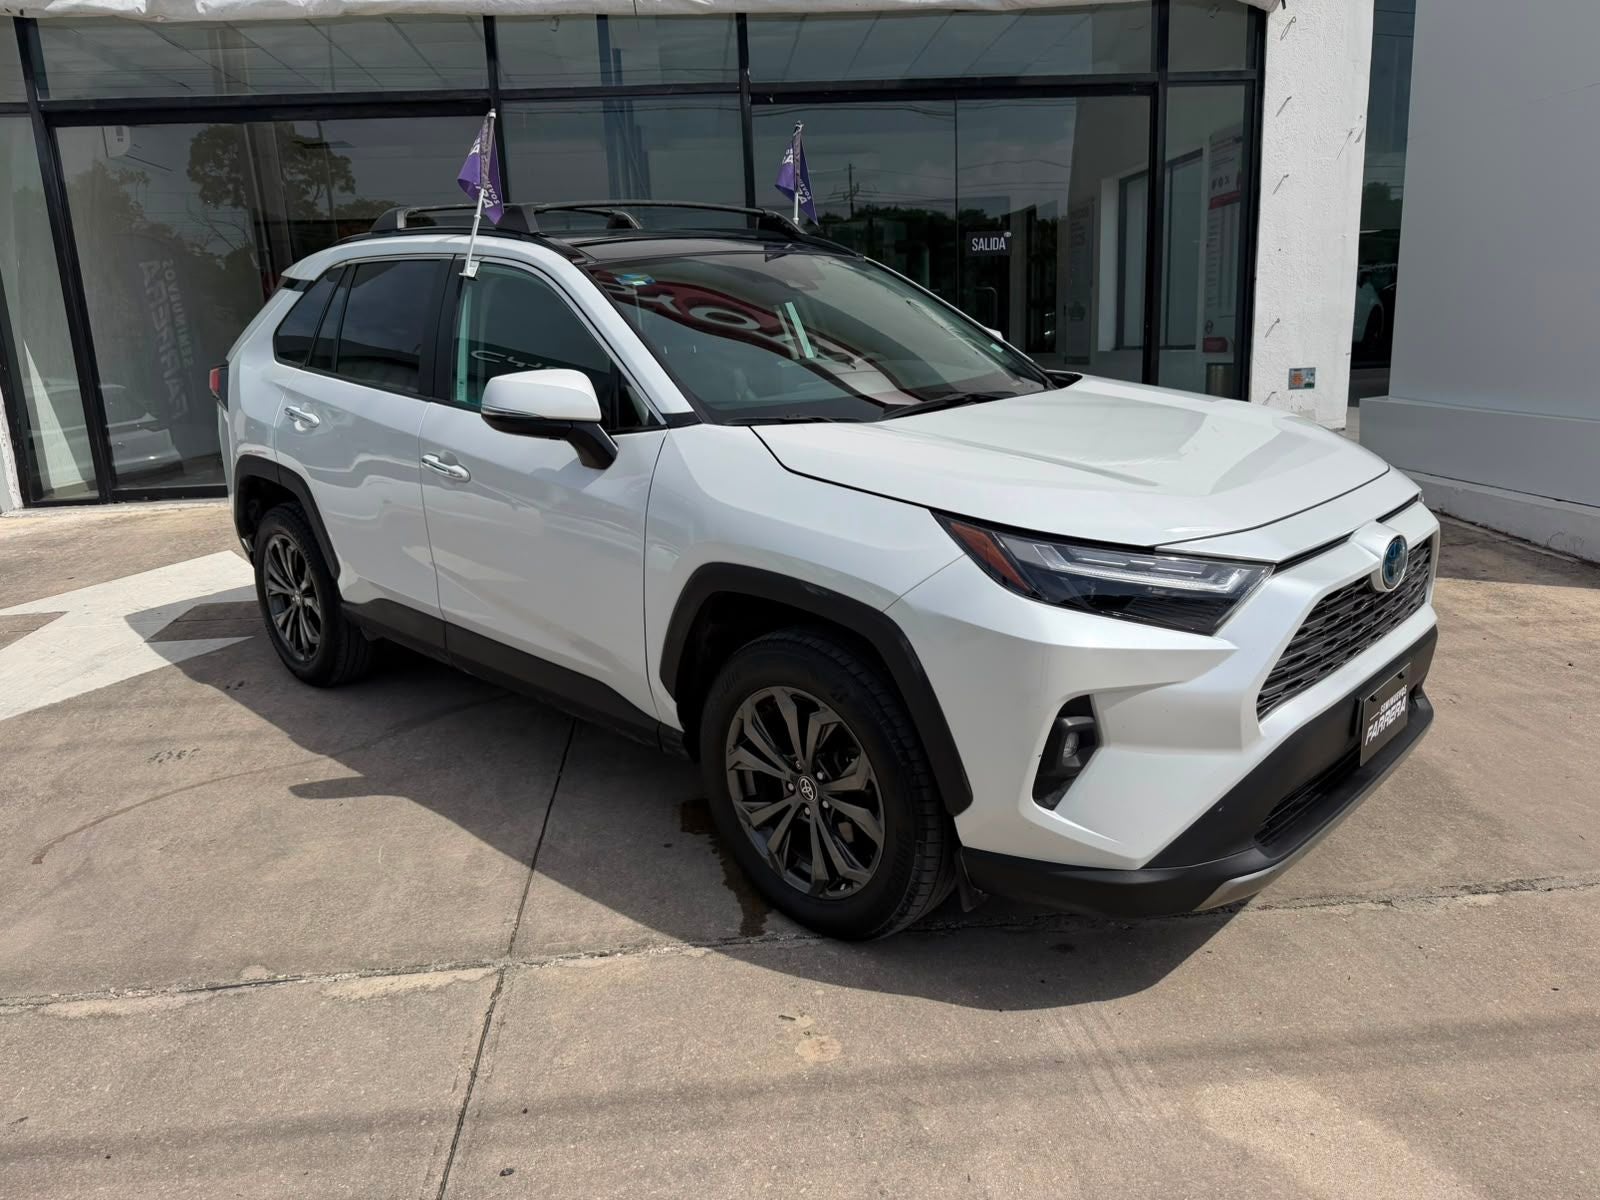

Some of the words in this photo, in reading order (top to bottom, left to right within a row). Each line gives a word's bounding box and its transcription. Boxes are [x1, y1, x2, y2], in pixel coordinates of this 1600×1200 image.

[971, 237, 1006, 252] SALIDA
[1380, 684, 1407, 715] SEMINUEVOS
[1365, 695, 1407, 746] FARRERA
